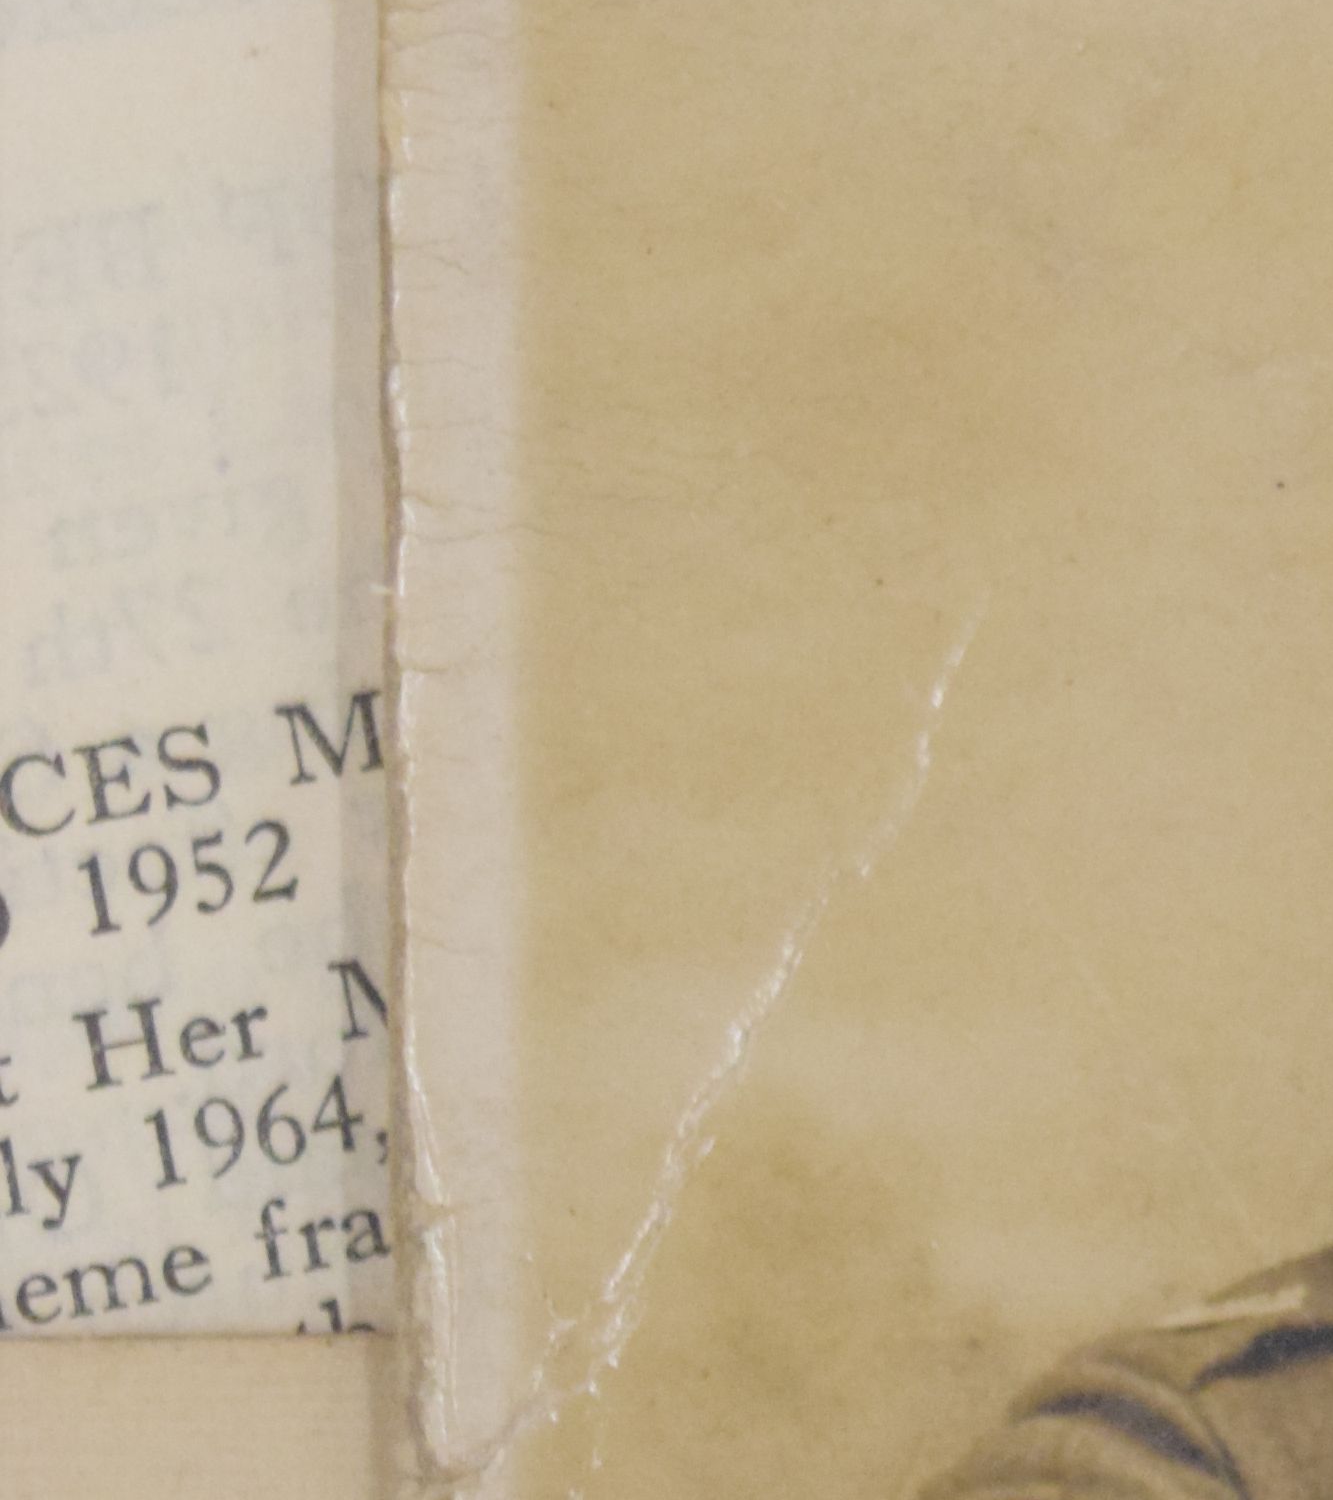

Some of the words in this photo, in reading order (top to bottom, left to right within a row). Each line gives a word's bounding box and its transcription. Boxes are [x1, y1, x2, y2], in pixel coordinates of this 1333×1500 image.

[0, 721, 221, 837] CES
[77, 819, 299, 937] 1952
[72, 997, 268, 1092] Her
[0, 1134, 83, 1231] ly
[143, 1073, 390, 1190] 1964,
[0, 1244, 213, 1333] eme
[254, 1197, 392, 1283] fra
